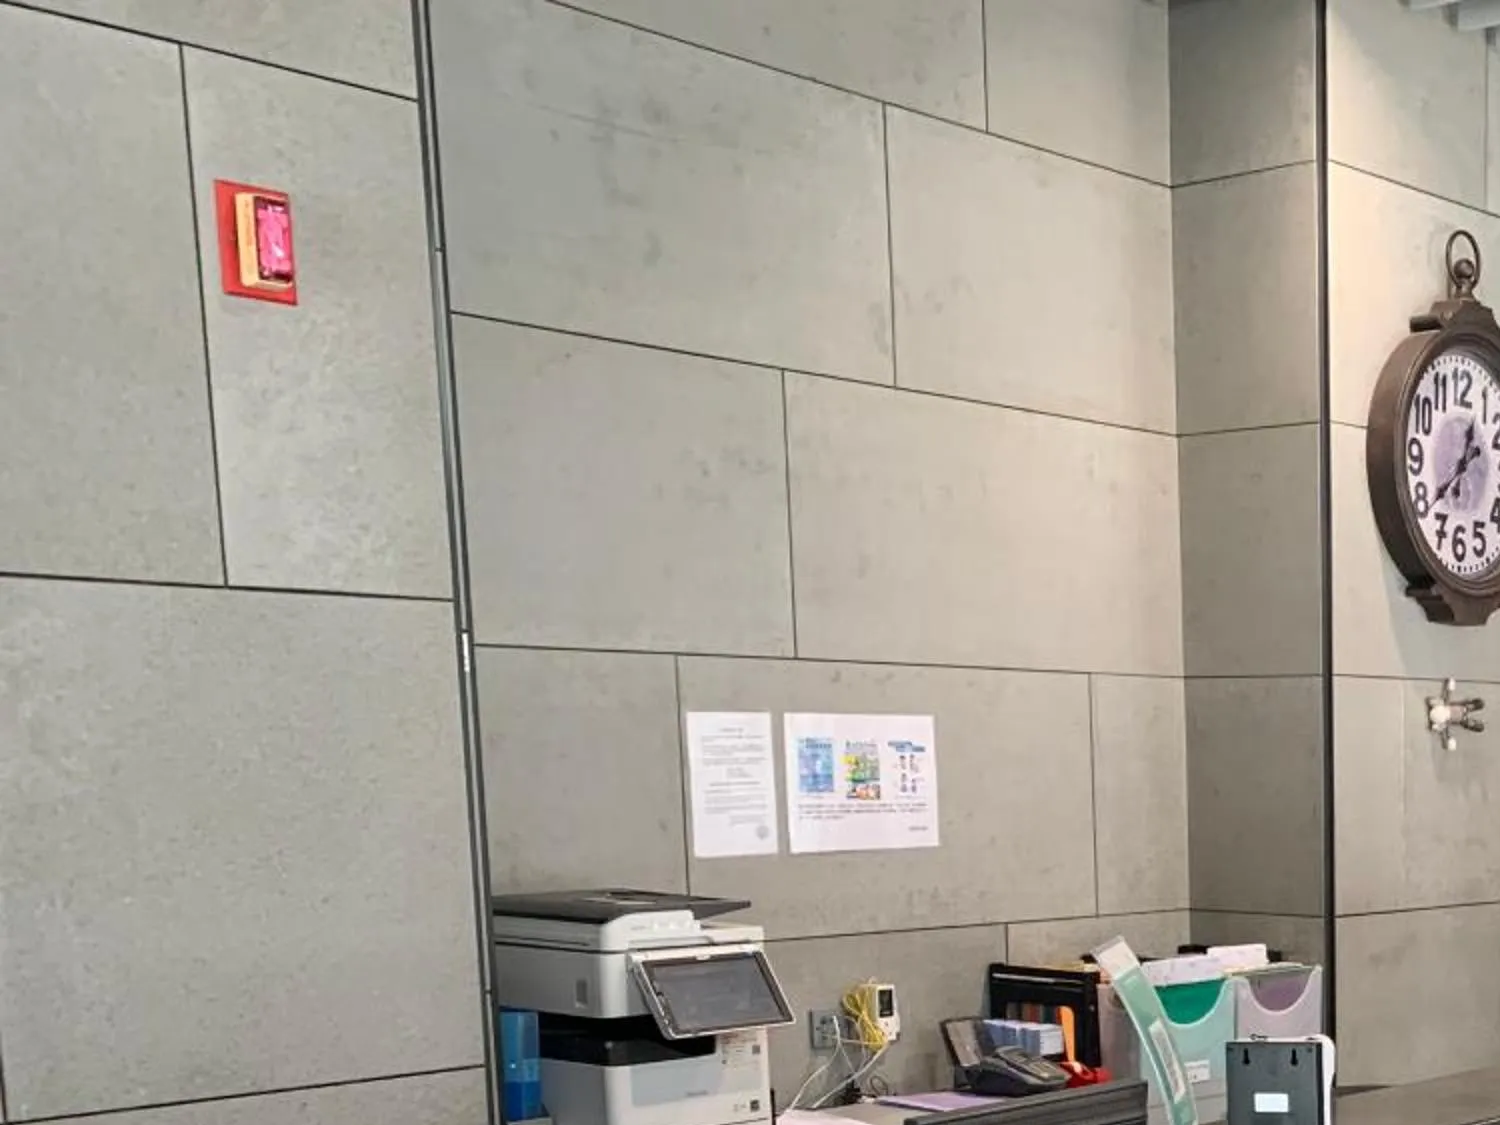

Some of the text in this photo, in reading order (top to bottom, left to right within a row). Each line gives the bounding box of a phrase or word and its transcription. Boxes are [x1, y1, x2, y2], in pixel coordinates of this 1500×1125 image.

[1433, 371, 1448, 413] 11
[1452, 367, 1473, 409] 12
[1481, 386, 1488, 425] 1
[1414, 394, 1432, 437] 10
[1407, 437, 1424, 477] 9
[1413, 481, 1430, 519] 8
[1434, 512, 1448, 550] 7
[1452, 524, 1467, 563] 6
[1472, 521, 1487, 558] 5
